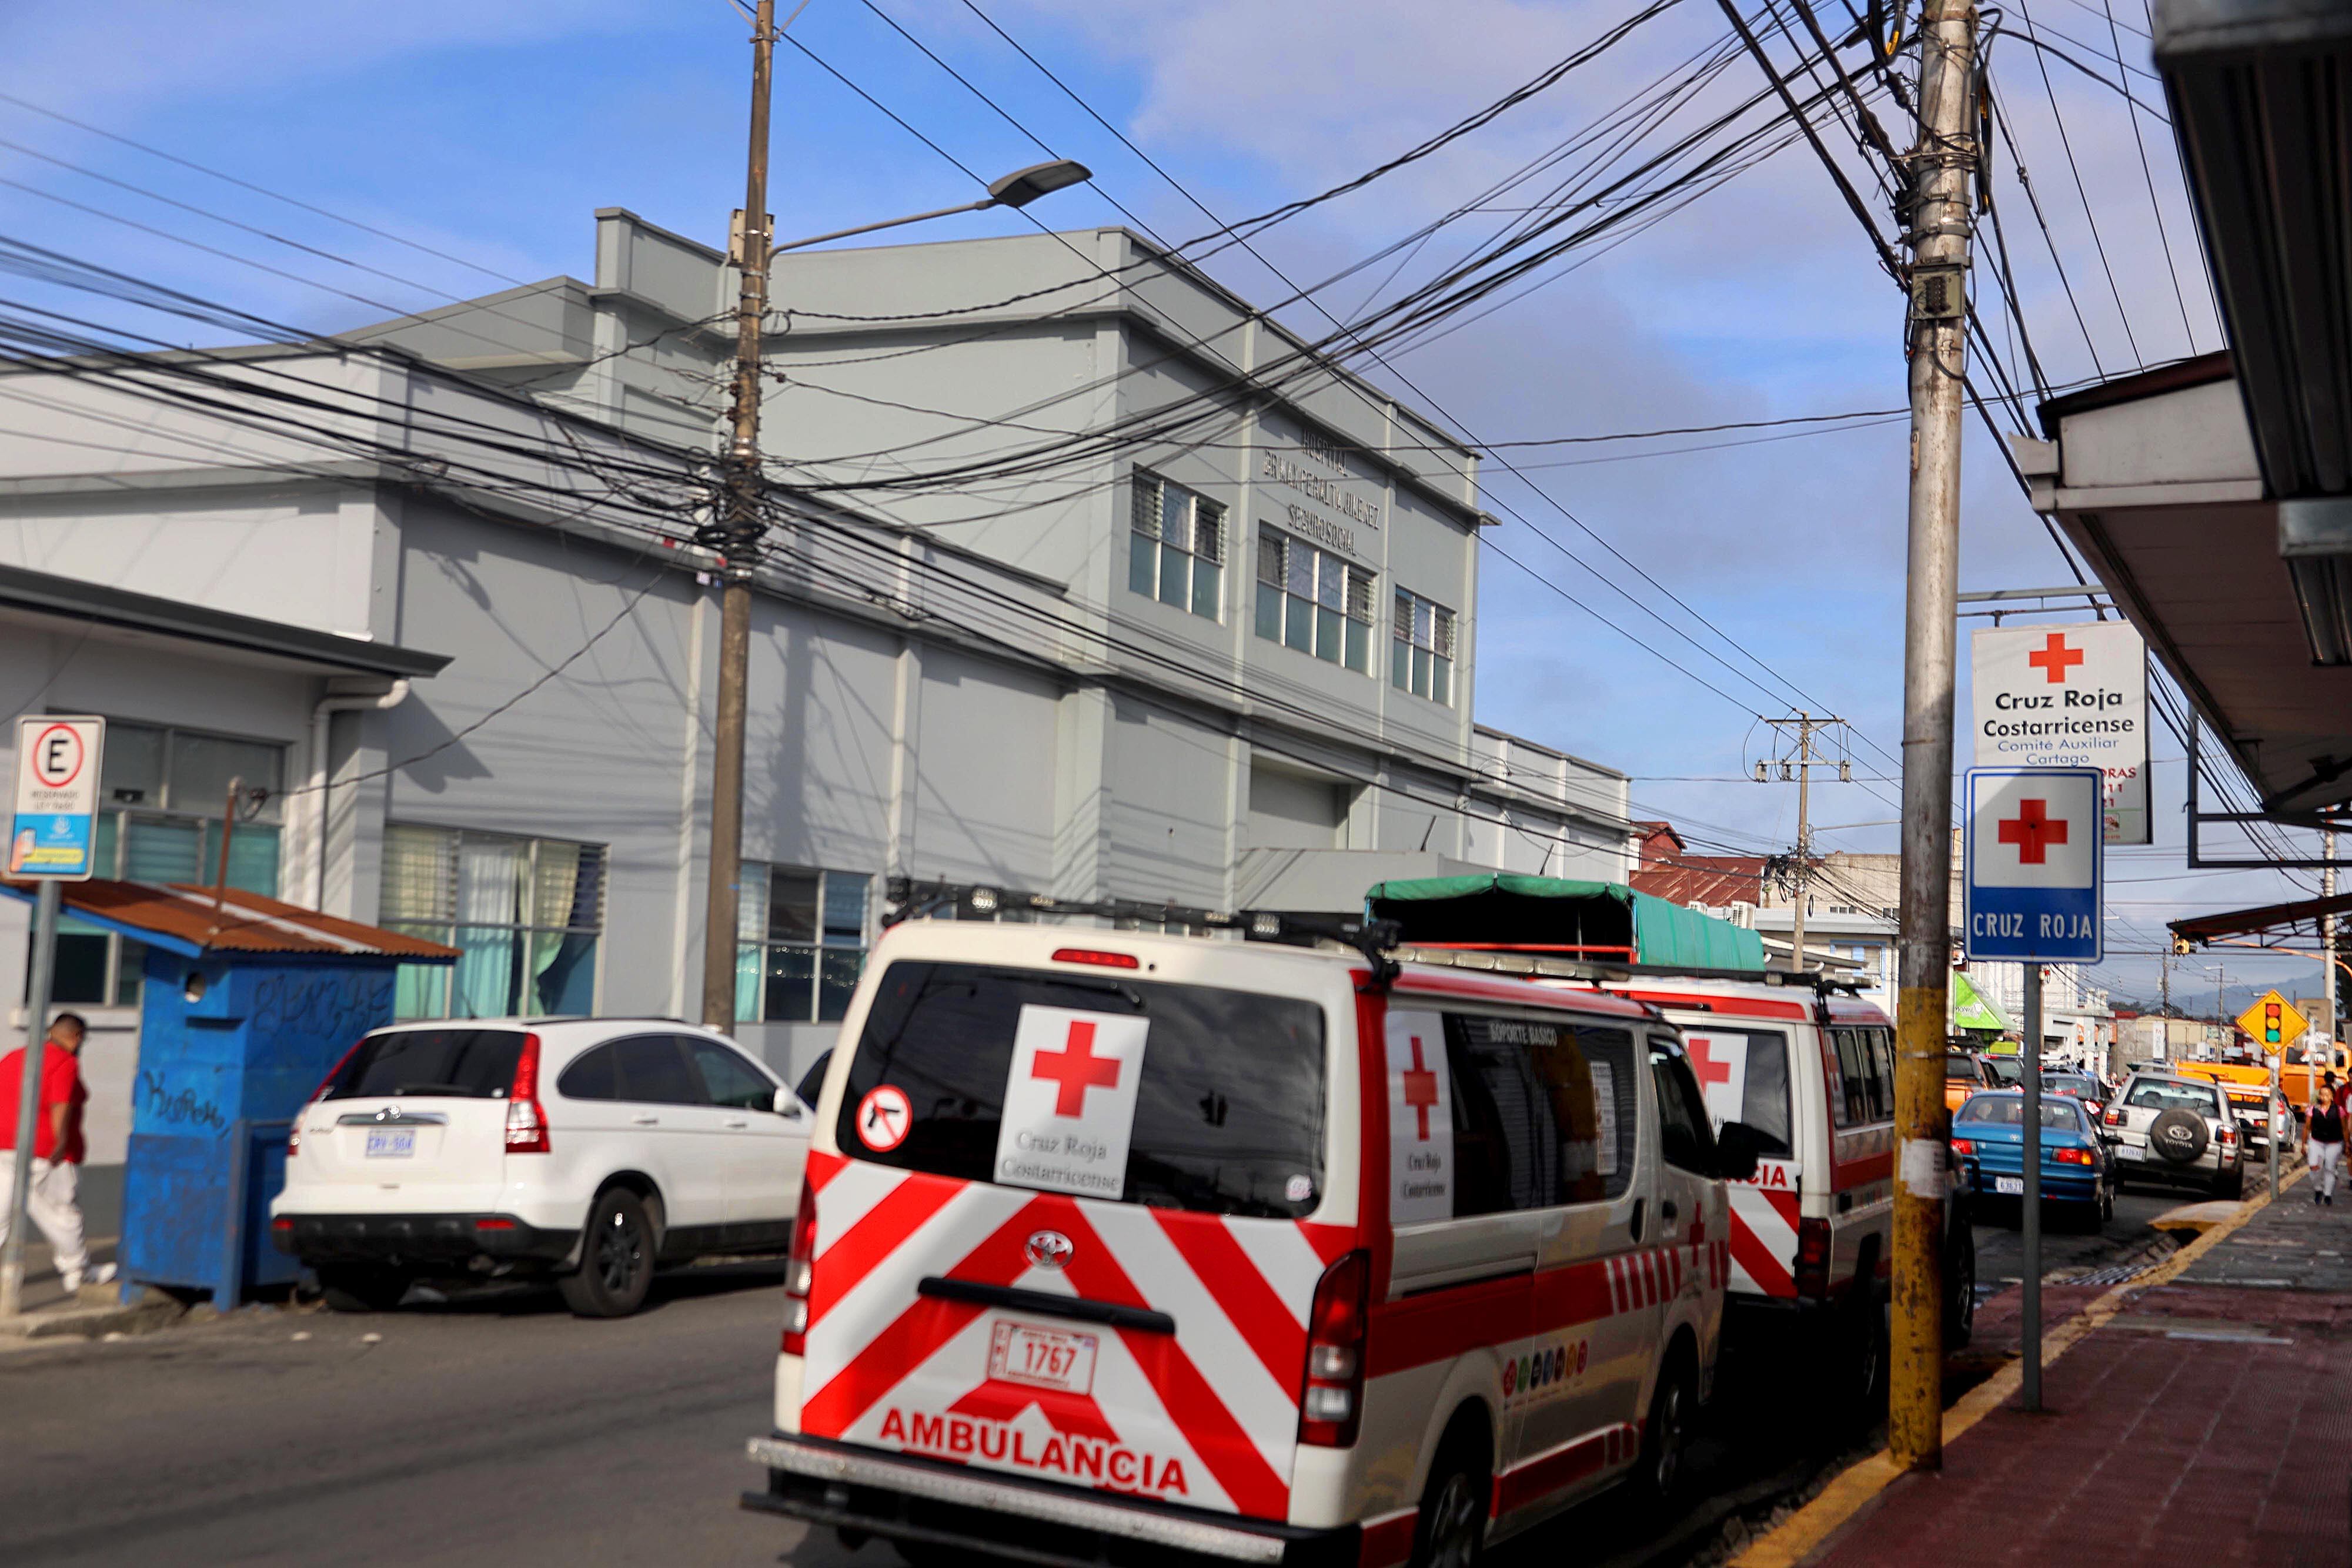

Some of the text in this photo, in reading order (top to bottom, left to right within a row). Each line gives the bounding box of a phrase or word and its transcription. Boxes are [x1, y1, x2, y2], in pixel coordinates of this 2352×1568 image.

[1344, 492, 1381, 530] JIMENEZ
[1288, 503, 1357, 556] SEGURO SOCIAL
[1996, 688, 2123, 711] Cruz Roja
[1984, 717, 2134, 737] Costarricense
[47, 740, 69, 773] E
[1998, 737, 2119, 752] Comité Auxiliar
[2026, 753, 2090, 767] Cartago
[1973, 912, 2093, 939] CRUZ ROJA
[1015, 1129, 1107, 1164] Cruz Roja
[2164, 1138, 2194, 1149] TOYOTA
[1025, 1342, 1078, 1376] 1767
[879, 1407, 1190, 1496] AMBULANCIA
